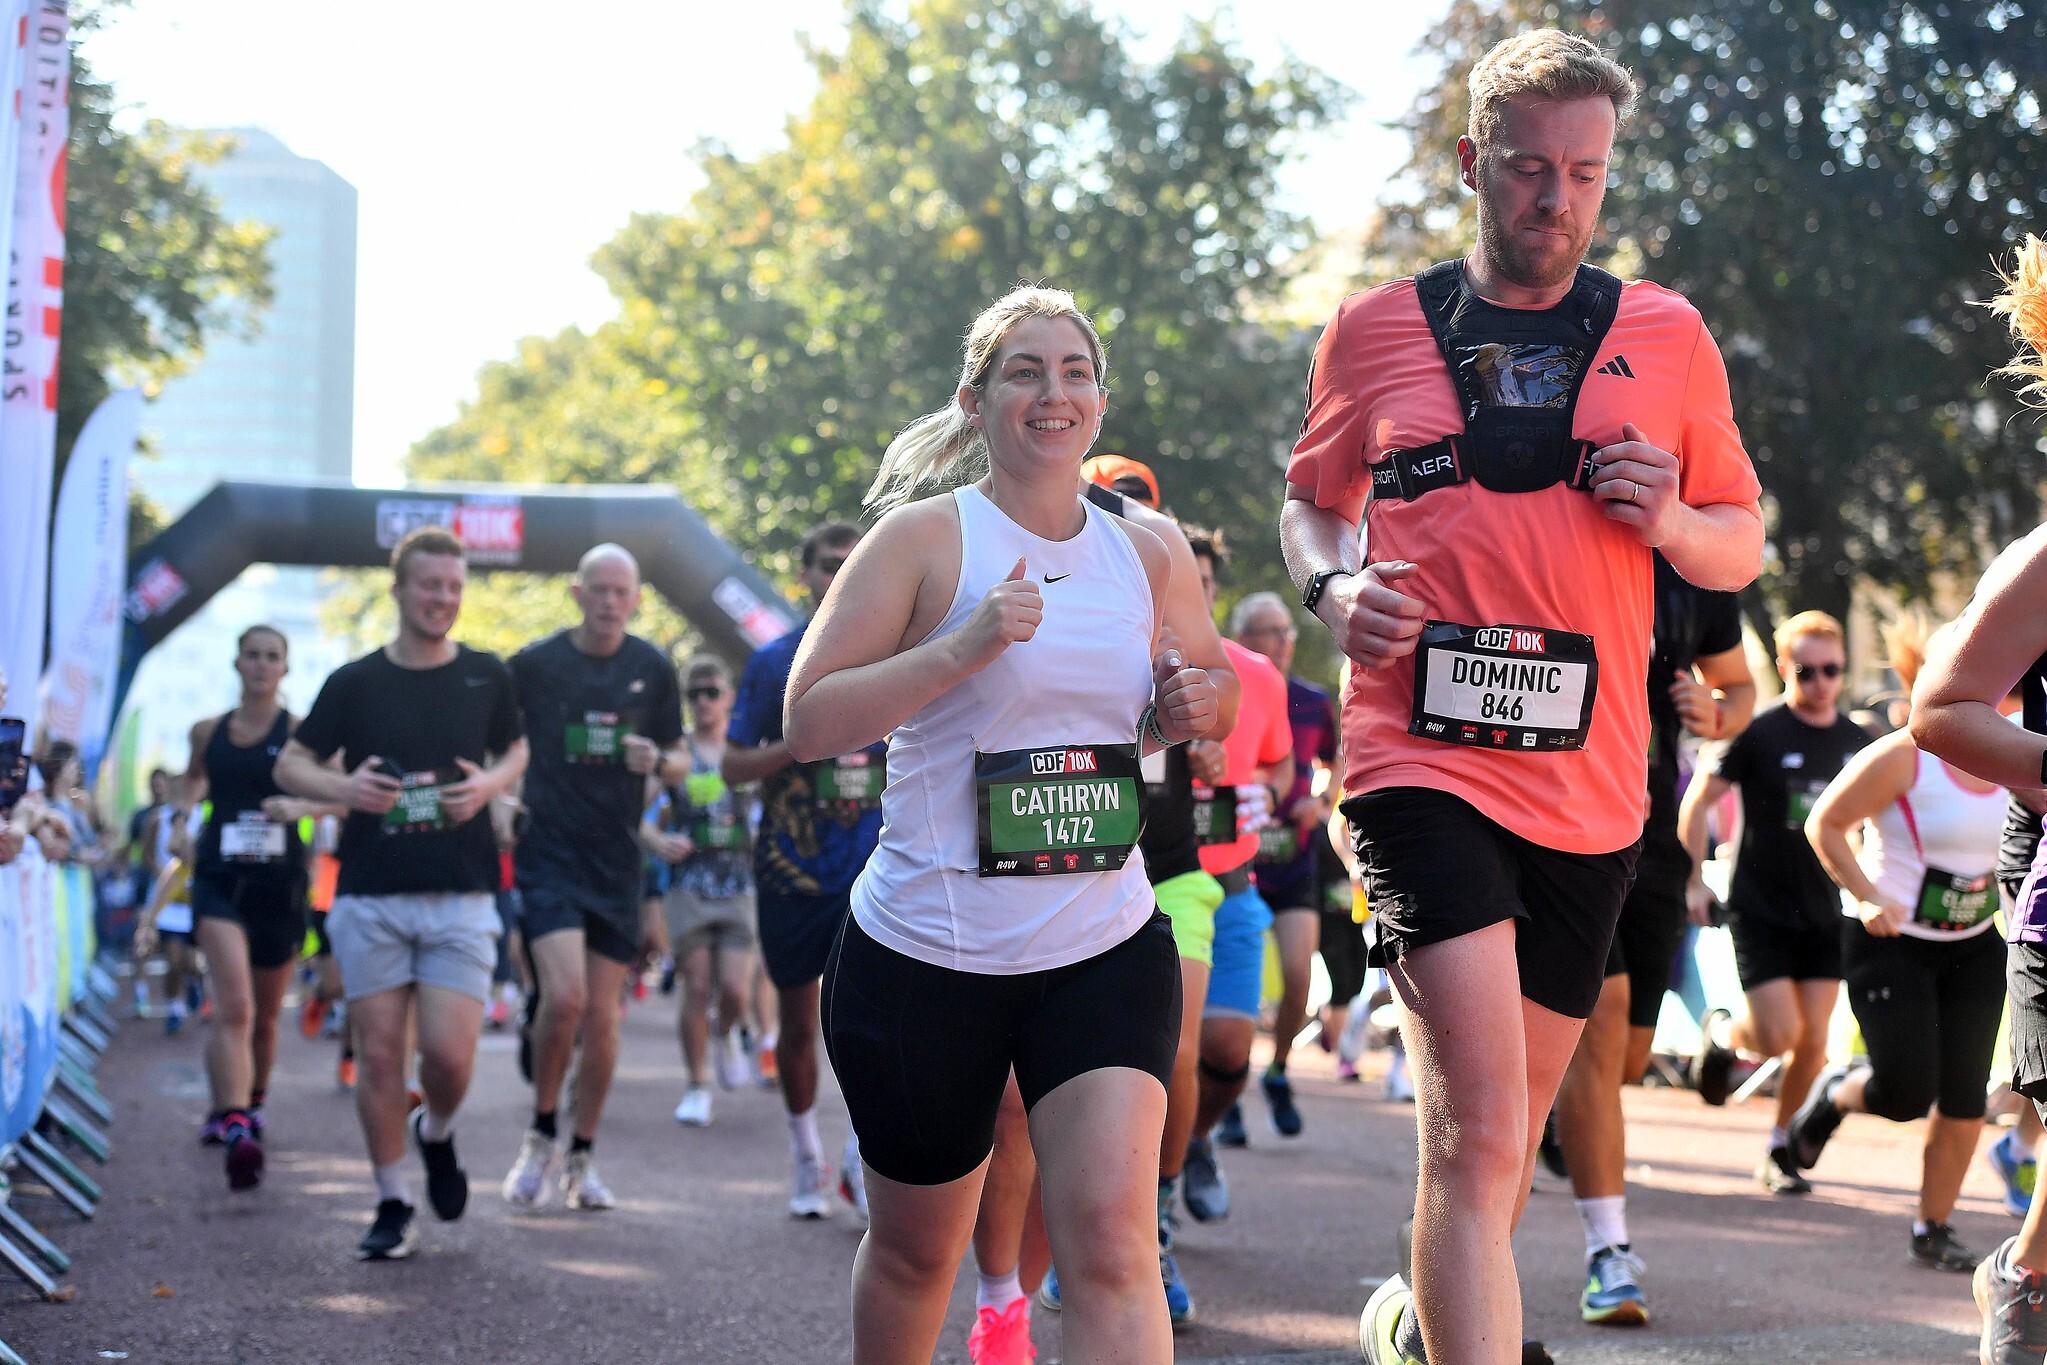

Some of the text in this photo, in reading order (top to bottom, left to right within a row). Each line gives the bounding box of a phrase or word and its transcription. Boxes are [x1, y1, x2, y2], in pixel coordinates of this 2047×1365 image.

[1476, 629, 1543, 651] CDF 10K
[1452, 656, 1562, 694] DOMINIC
[1481, 692, 1524, 721] 846
[1032, 751, 1096, 774] CDF 10K
[1011, 782, 1120, 817] CATHRYN
[1042, 816, 1096, 846] 1472
